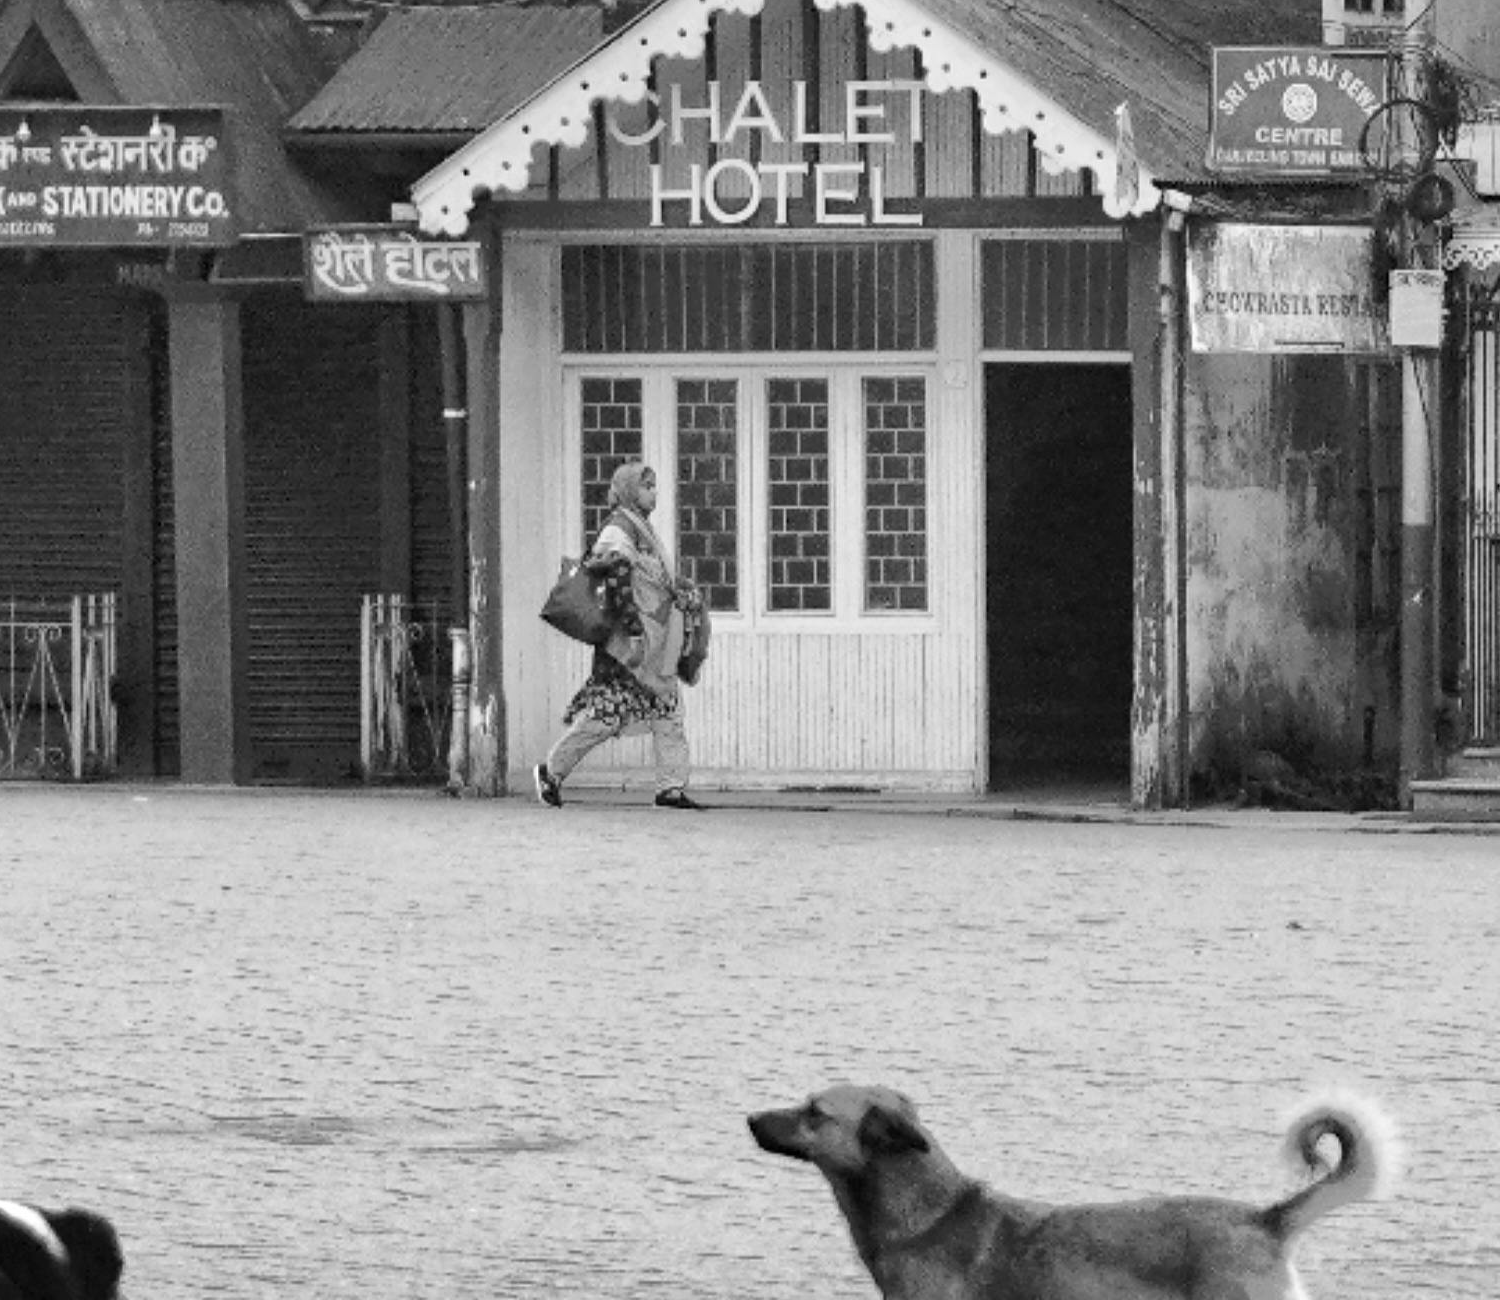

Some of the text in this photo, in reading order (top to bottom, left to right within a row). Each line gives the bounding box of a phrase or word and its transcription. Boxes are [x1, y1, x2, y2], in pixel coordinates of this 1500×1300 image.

[608, 78, 925, 145] CHALET
[1218, 80, 1248, 116] SRI
[1243, 55, 1301, 91] SATYA
[1305, 55, 1338, 82] SAI
[1255, 127, 1343, 146] CENTRE
[7, 191, 38, 207] AND
[42, 185, 185, 218] STATIONERY
[186, 186, 230, 219] Co.
[650, 158, 923, 226] HOTEL
[380, 231, 482, 294] होटल
[1203, 290, 1312, 316] CHOWRASTA
